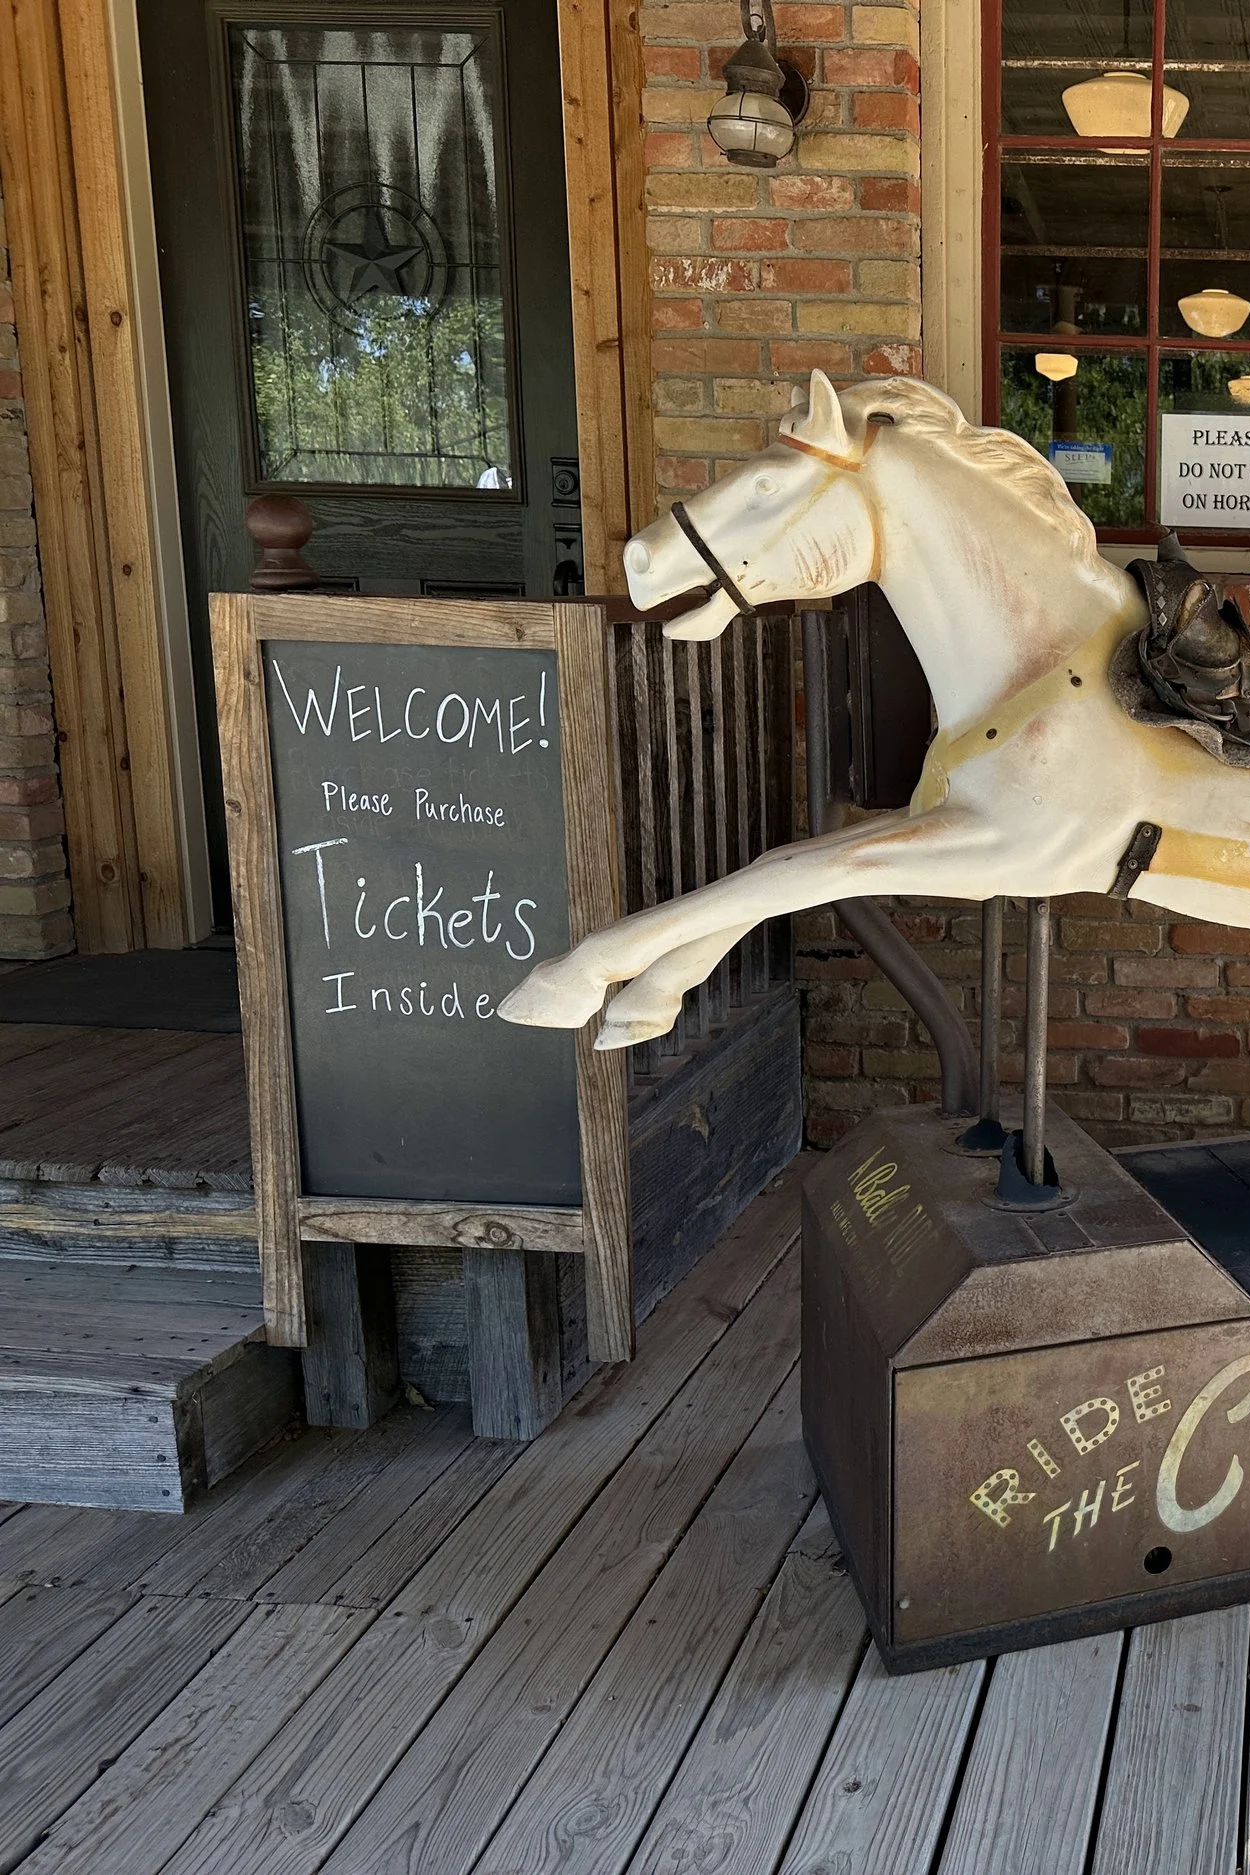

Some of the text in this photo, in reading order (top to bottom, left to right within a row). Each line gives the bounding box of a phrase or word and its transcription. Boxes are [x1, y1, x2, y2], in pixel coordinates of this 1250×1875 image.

[1179, 462, 1203, 478] DO
[1209, 463, 1247, 479] NOT
[1182, 493, 1207, 510] ON
[272, 659, 550, 755] WELCOME!
[321, 780, 393, 816] Please
[415, 787, 505, 828] Purchase
[291, 837, 537, 961] Tickets
[322, 972, 500, 1019] Inside
[968, 1364, 1173, 1529] RIDE
[1042, 1459, 1141, 1552] THE
